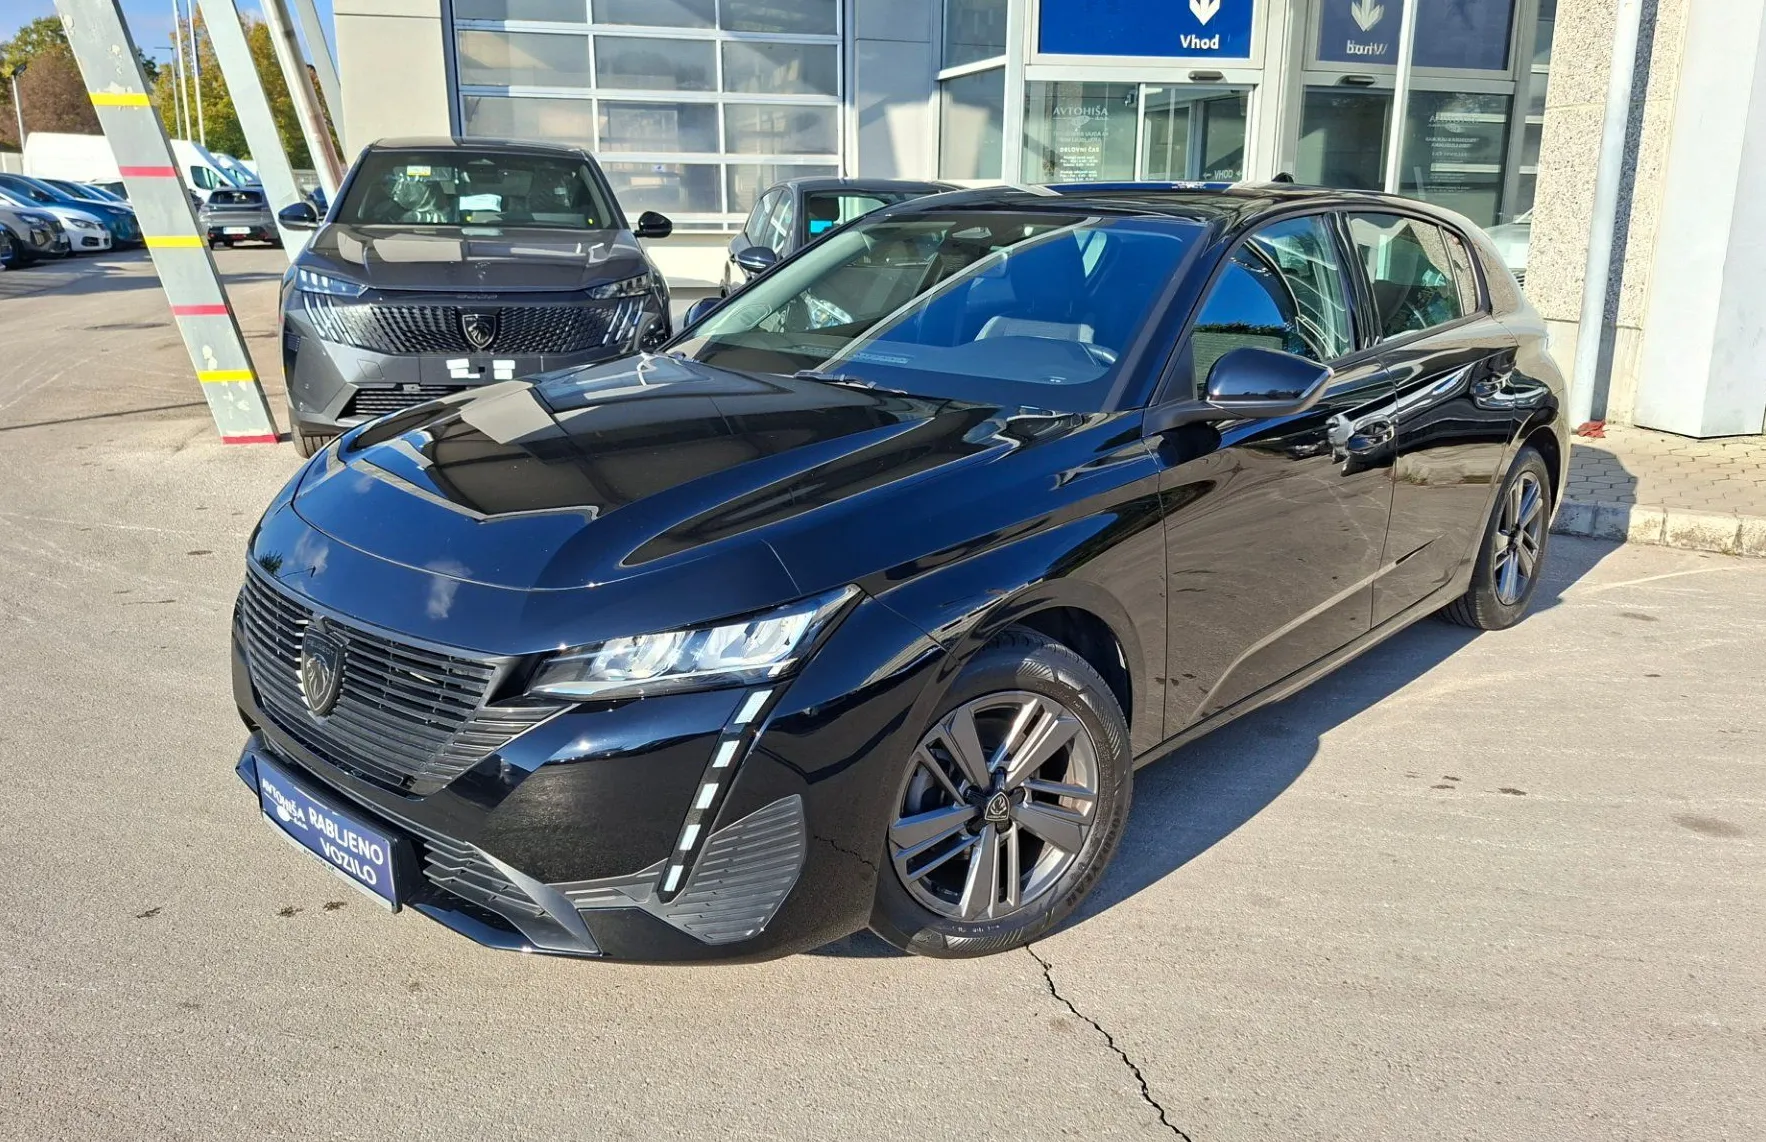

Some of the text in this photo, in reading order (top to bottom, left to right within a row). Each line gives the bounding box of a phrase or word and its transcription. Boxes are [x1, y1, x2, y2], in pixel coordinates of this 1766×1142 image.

[1180, 34, 1219, 49] Vhod
[1053, 105, 1108, 116] AVTOHIŠA
[1214, 170, 1233, 180] VHOD
[308, 806, 384, 866] RABLJENO
[320, 837, 377, 885] VOZILO
